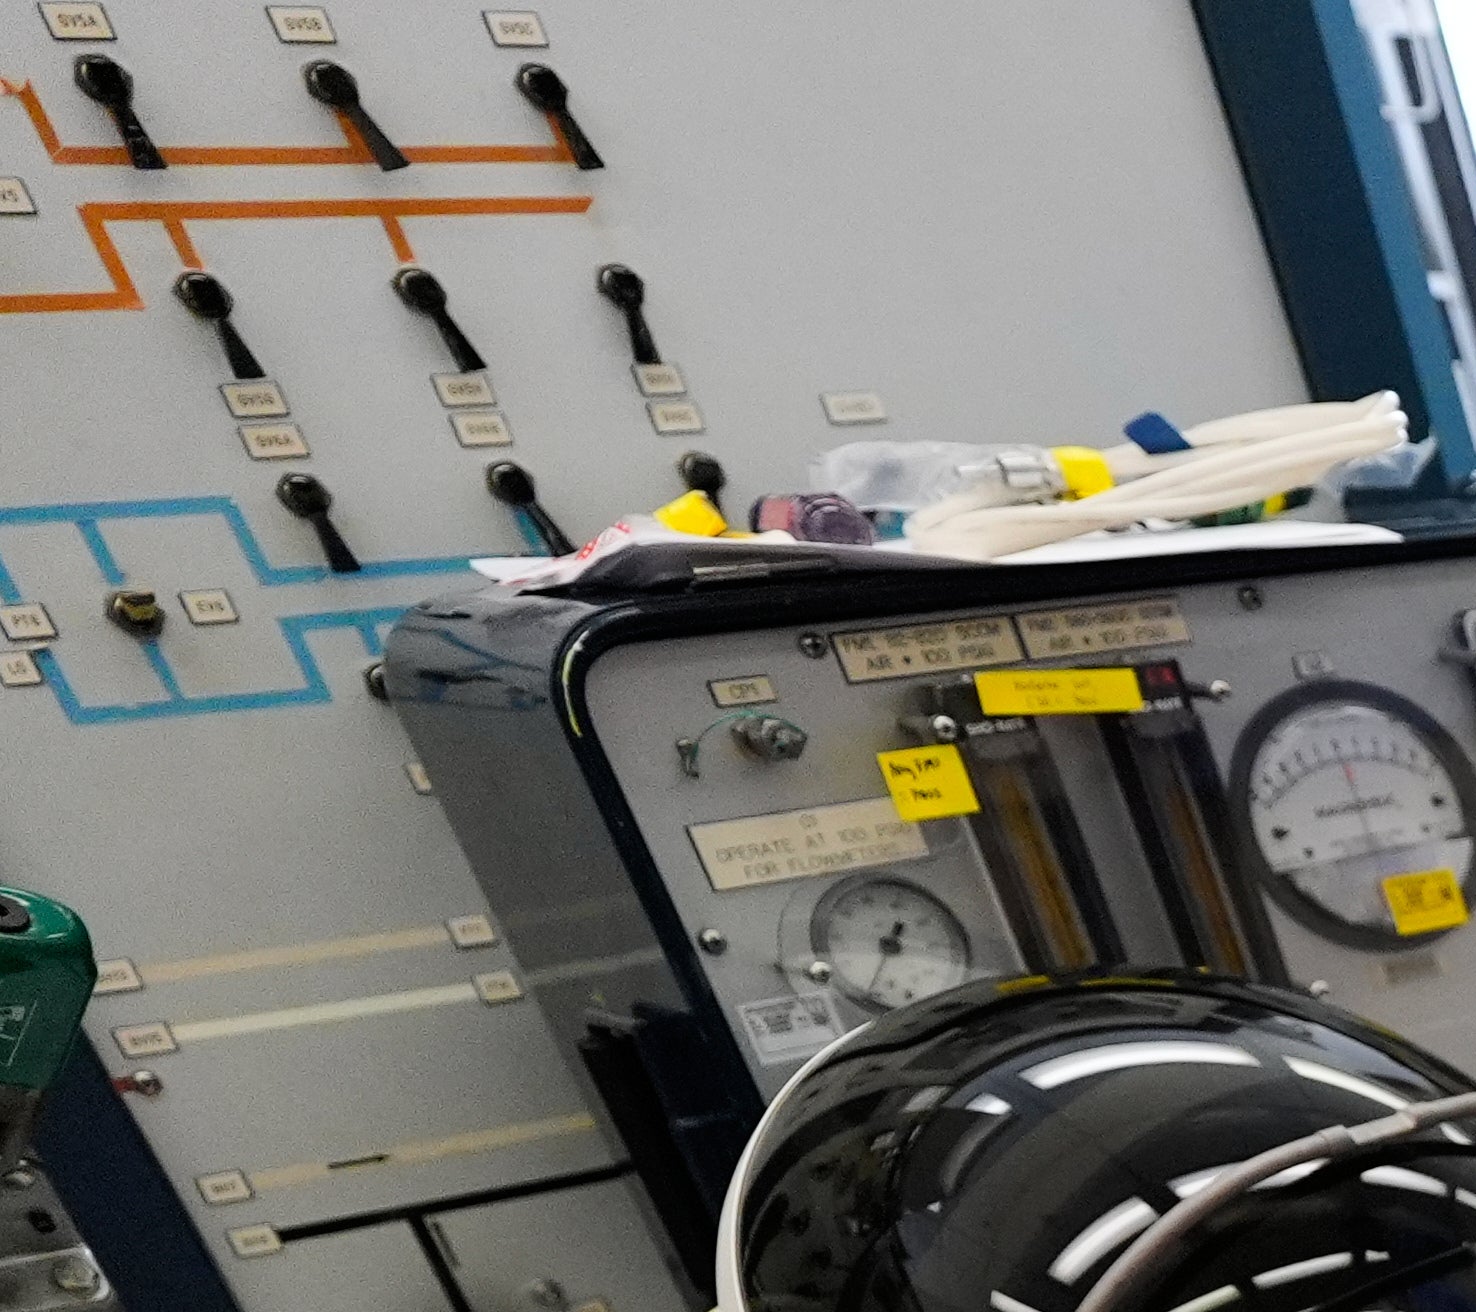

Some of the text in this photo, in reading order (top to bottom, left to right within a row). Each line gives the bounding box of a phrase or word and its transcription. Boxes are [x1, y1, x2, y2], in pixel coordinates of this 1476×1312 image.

[715, 837, 794, 865] OPERATE
[805, 831, 826, 849] AT
[744, 860, 780, 880] FOR
